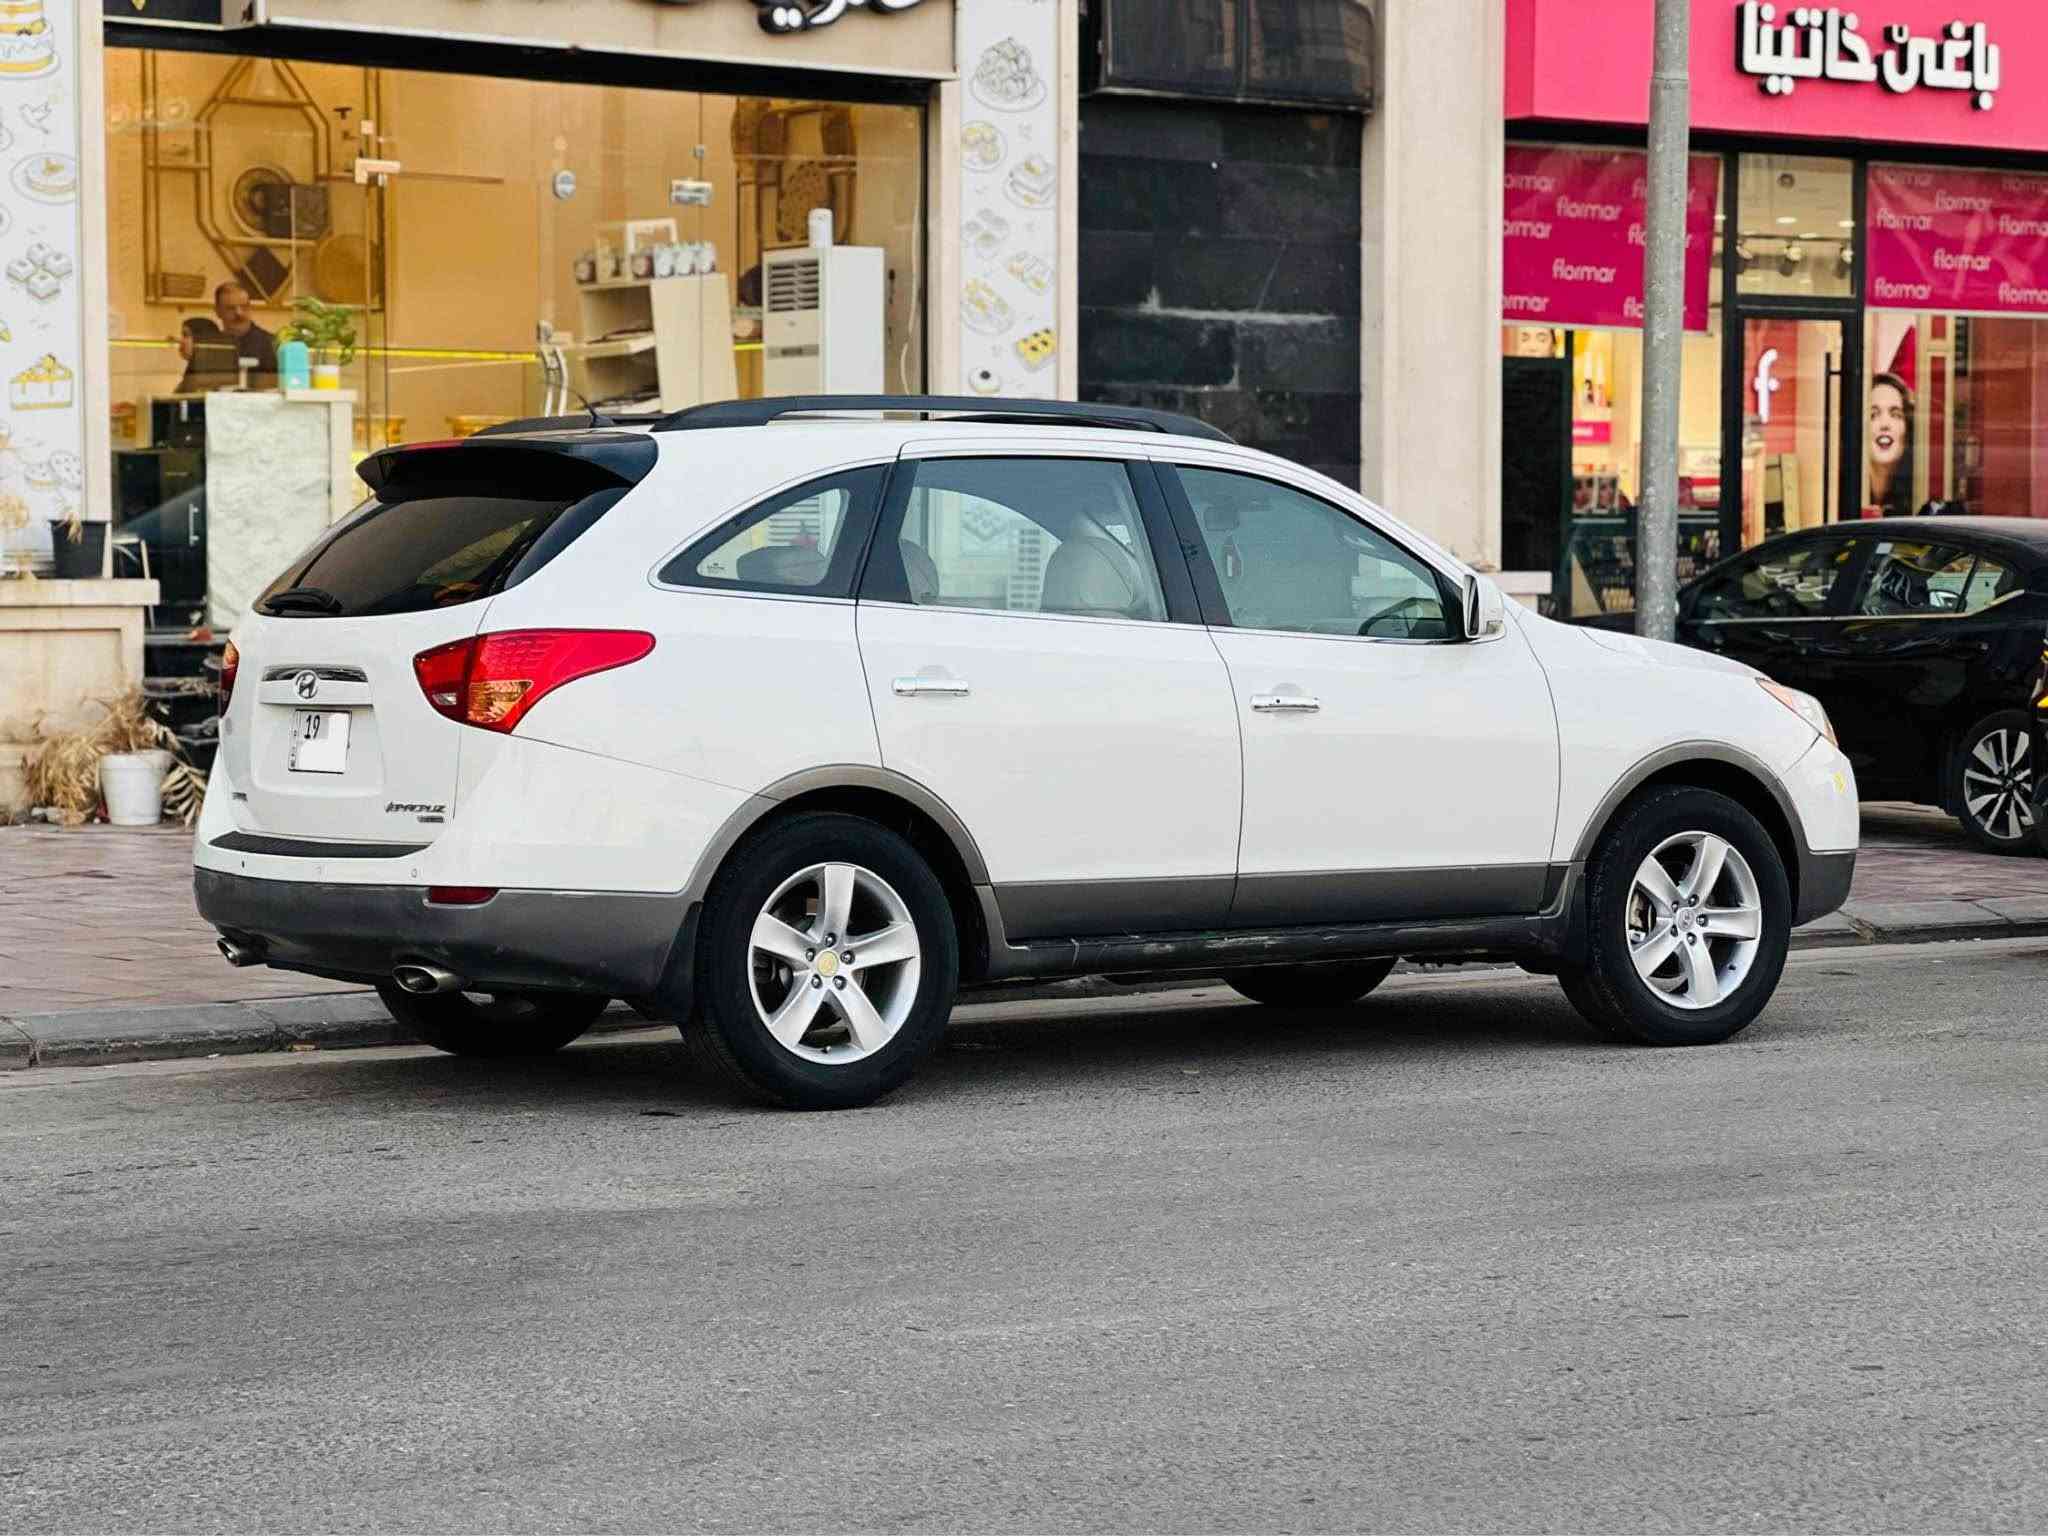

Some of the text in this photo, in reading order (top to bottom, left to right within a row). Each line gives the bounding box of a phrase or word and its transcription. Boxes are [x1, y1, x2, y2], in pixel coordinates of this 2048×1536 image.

[1556, 195, 1621, 221] flormar
[1935, 189, 1992, 212] flormar
[1503, 220, 1552, 239] ormar
[1876, 208, 1932, 230] flormar
[2000, 214, 2048, 237] florma
[1552, 257, 1616, 282] flormar
[1933, 248, 1991, 271] flormar
[1875, 277, 1931, 300] flormar
[1999, 282, 2048, 304] florma
[304, 715, 320, 739] 19
